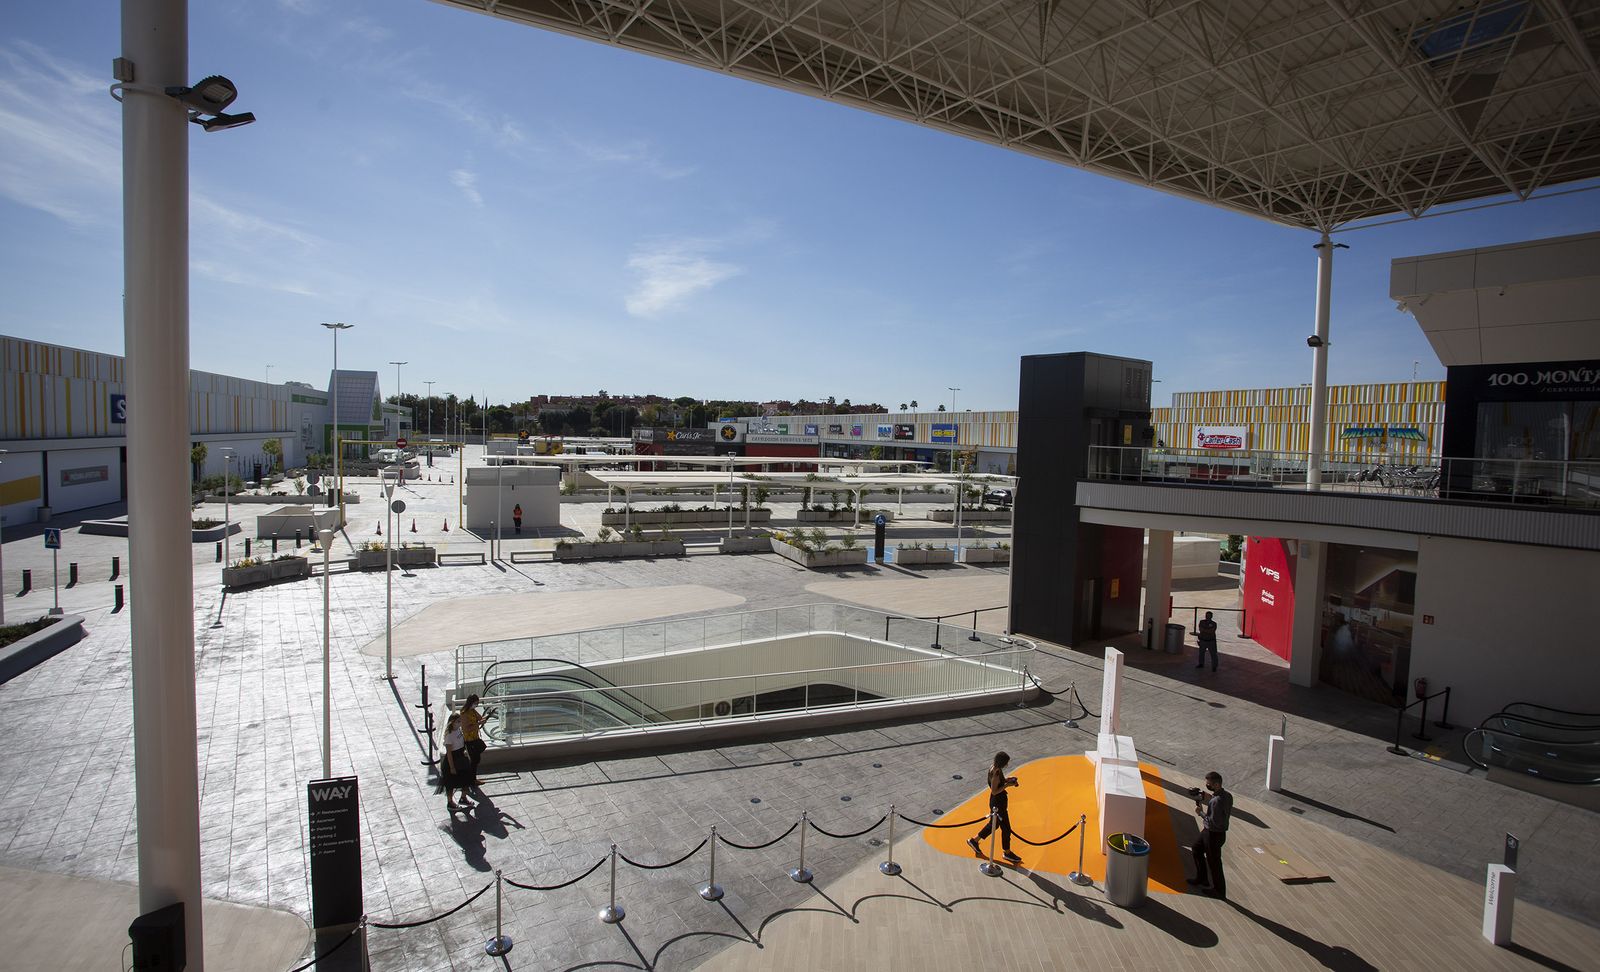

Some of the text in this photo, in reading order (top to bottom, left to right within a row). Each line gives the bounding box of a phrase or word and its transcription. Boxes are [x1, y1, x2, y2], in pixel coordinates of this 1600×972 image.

[1488, 373, 1529, 386] 100
[1260, 565, 1280, 579] VIPS
[312, 786, 352, 801] WAY
[1488, 872, 1496, 905] Welcome
